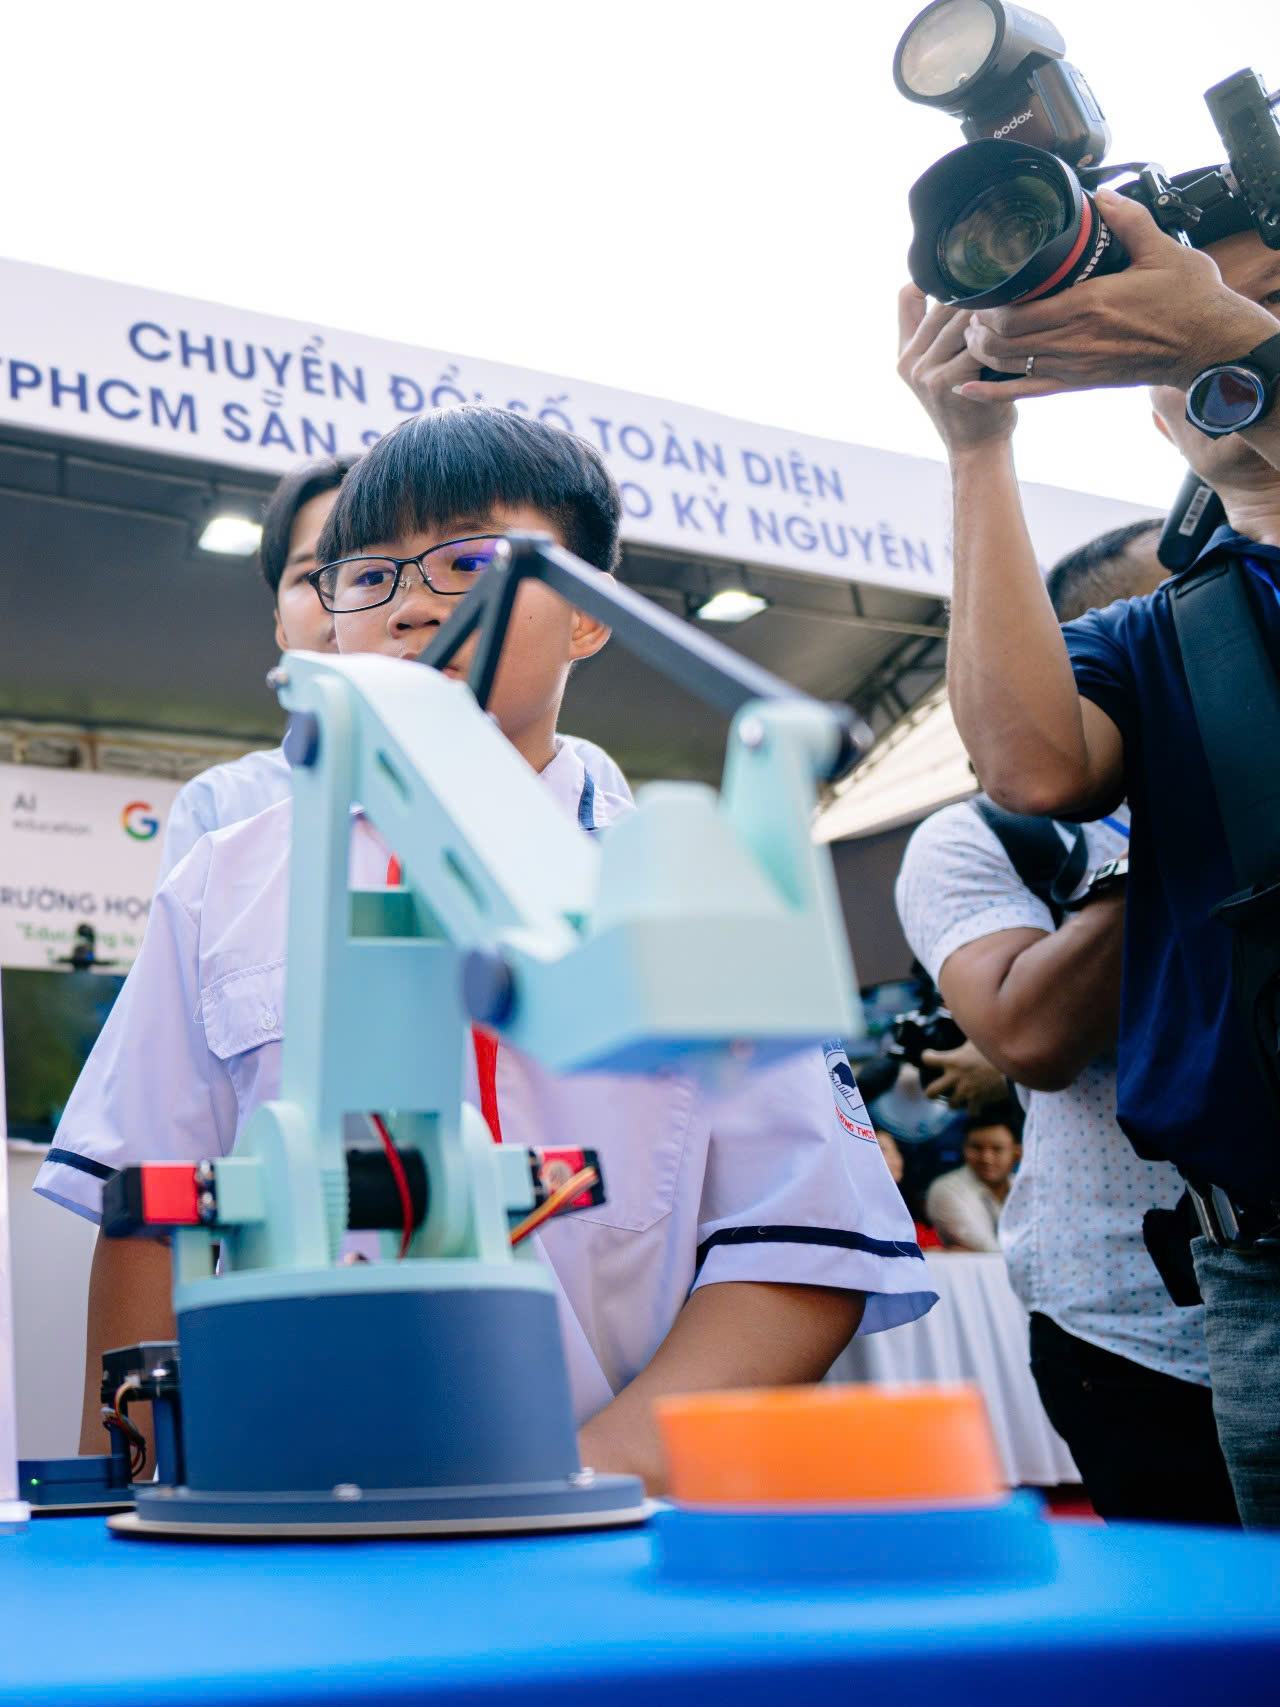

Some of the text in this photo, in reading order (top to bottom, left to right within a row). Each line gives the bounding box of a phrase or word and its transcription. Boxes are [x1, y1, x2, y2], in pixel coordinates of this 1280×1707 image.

[993, 109, 1034, 139] Godox
[129, 321, 367, 405] CHUYỂN
[389, 364, 484, 413] ĐỔ
[590, 417, 727, 480] TOÀN
[742, 449, 845, 508] DIỆN
[748, 507, 935, 575] NGUYÊN
[122, 801, 159, 841] G
